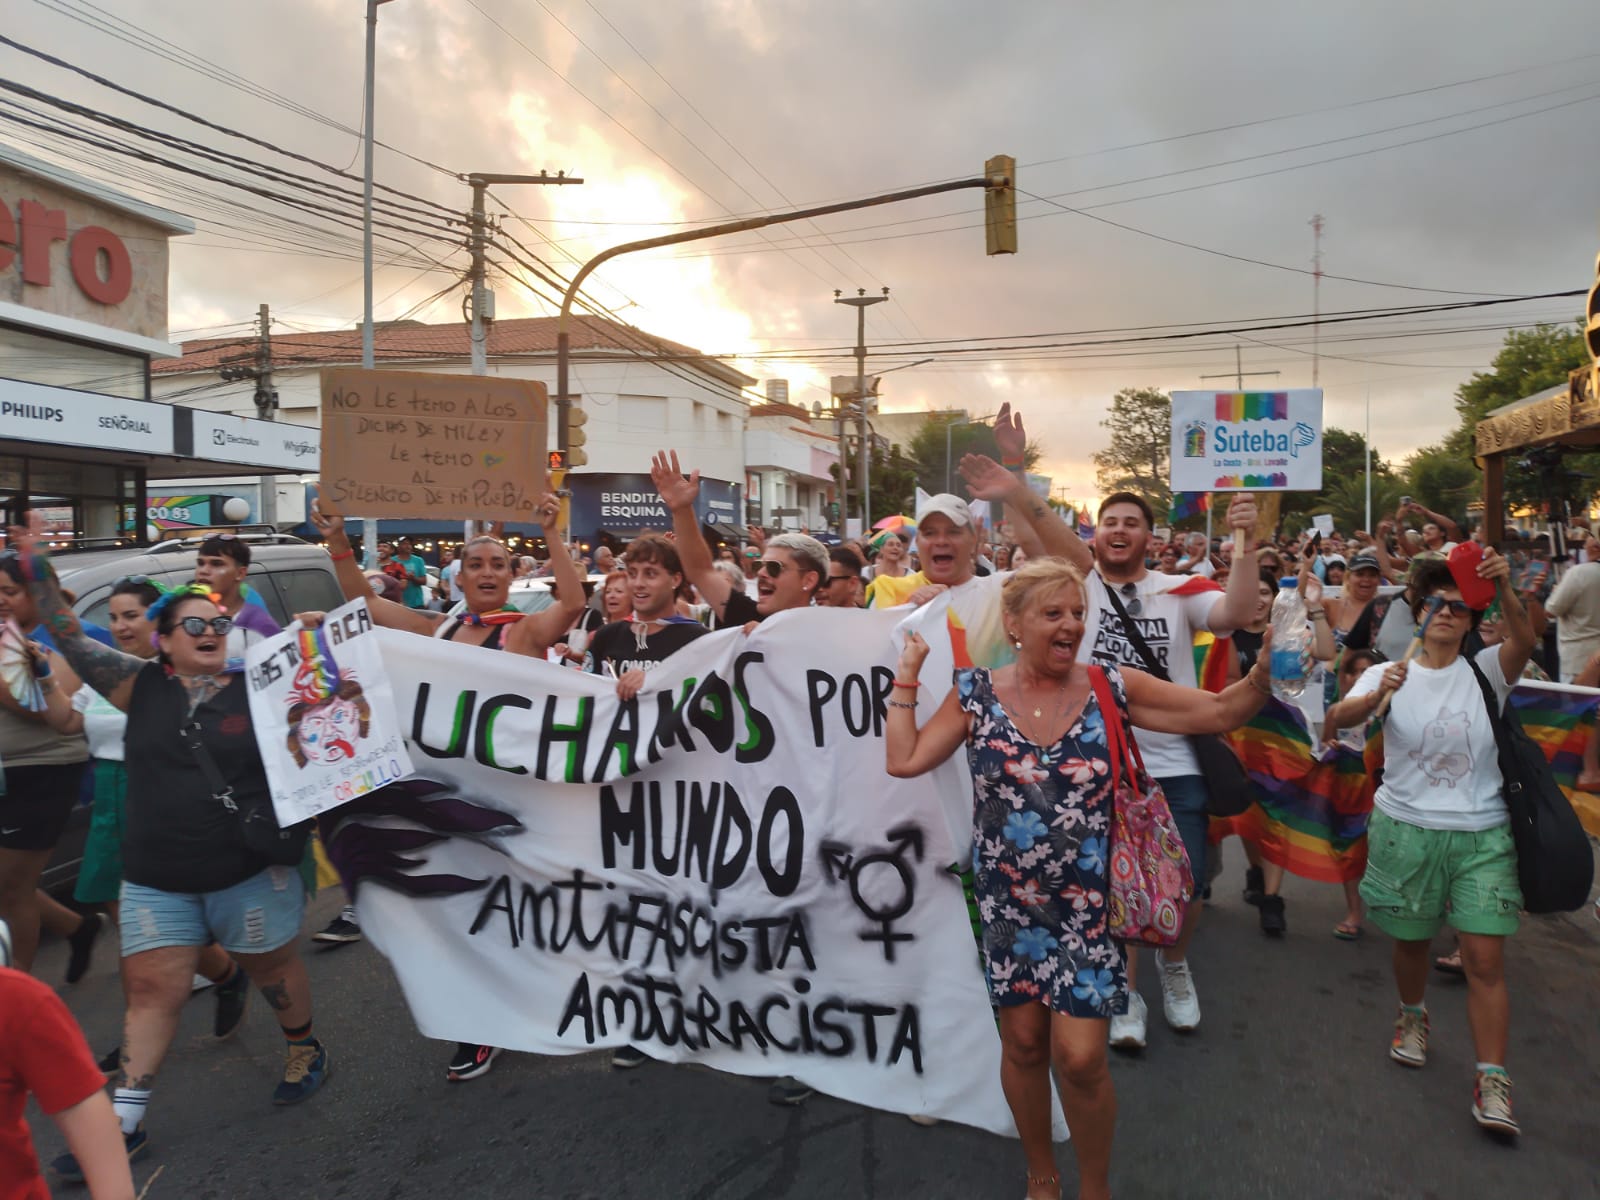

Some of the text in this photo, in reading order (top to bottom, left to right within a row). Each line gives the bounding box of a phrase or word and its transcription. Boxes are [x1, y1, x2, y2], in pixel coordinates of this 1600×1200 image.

[332, 386, 361, 409] NO
[374, 385, 398, 409] LE
[464, 397, 478, 415] A
[2, 401, 64, 422] PHILIPS
[416, 421, 436, 438] DE
[1214, 425, 1289, 453] Suteba
[391, 442, 410, 462] LE
[411, 469, 437, 484] AL
[423, 486, 444, 505] DE
[601, 492, 666, 504] BENDITA
[172, 507, 190, 521] 83
[601, 505, 667, 518] ESQUINA
[406, 651, 895, 784] UCHAMOS POR
[334, 759, 402, 801] ORGULLO
[599, 779, 804, 897] MUNDO
